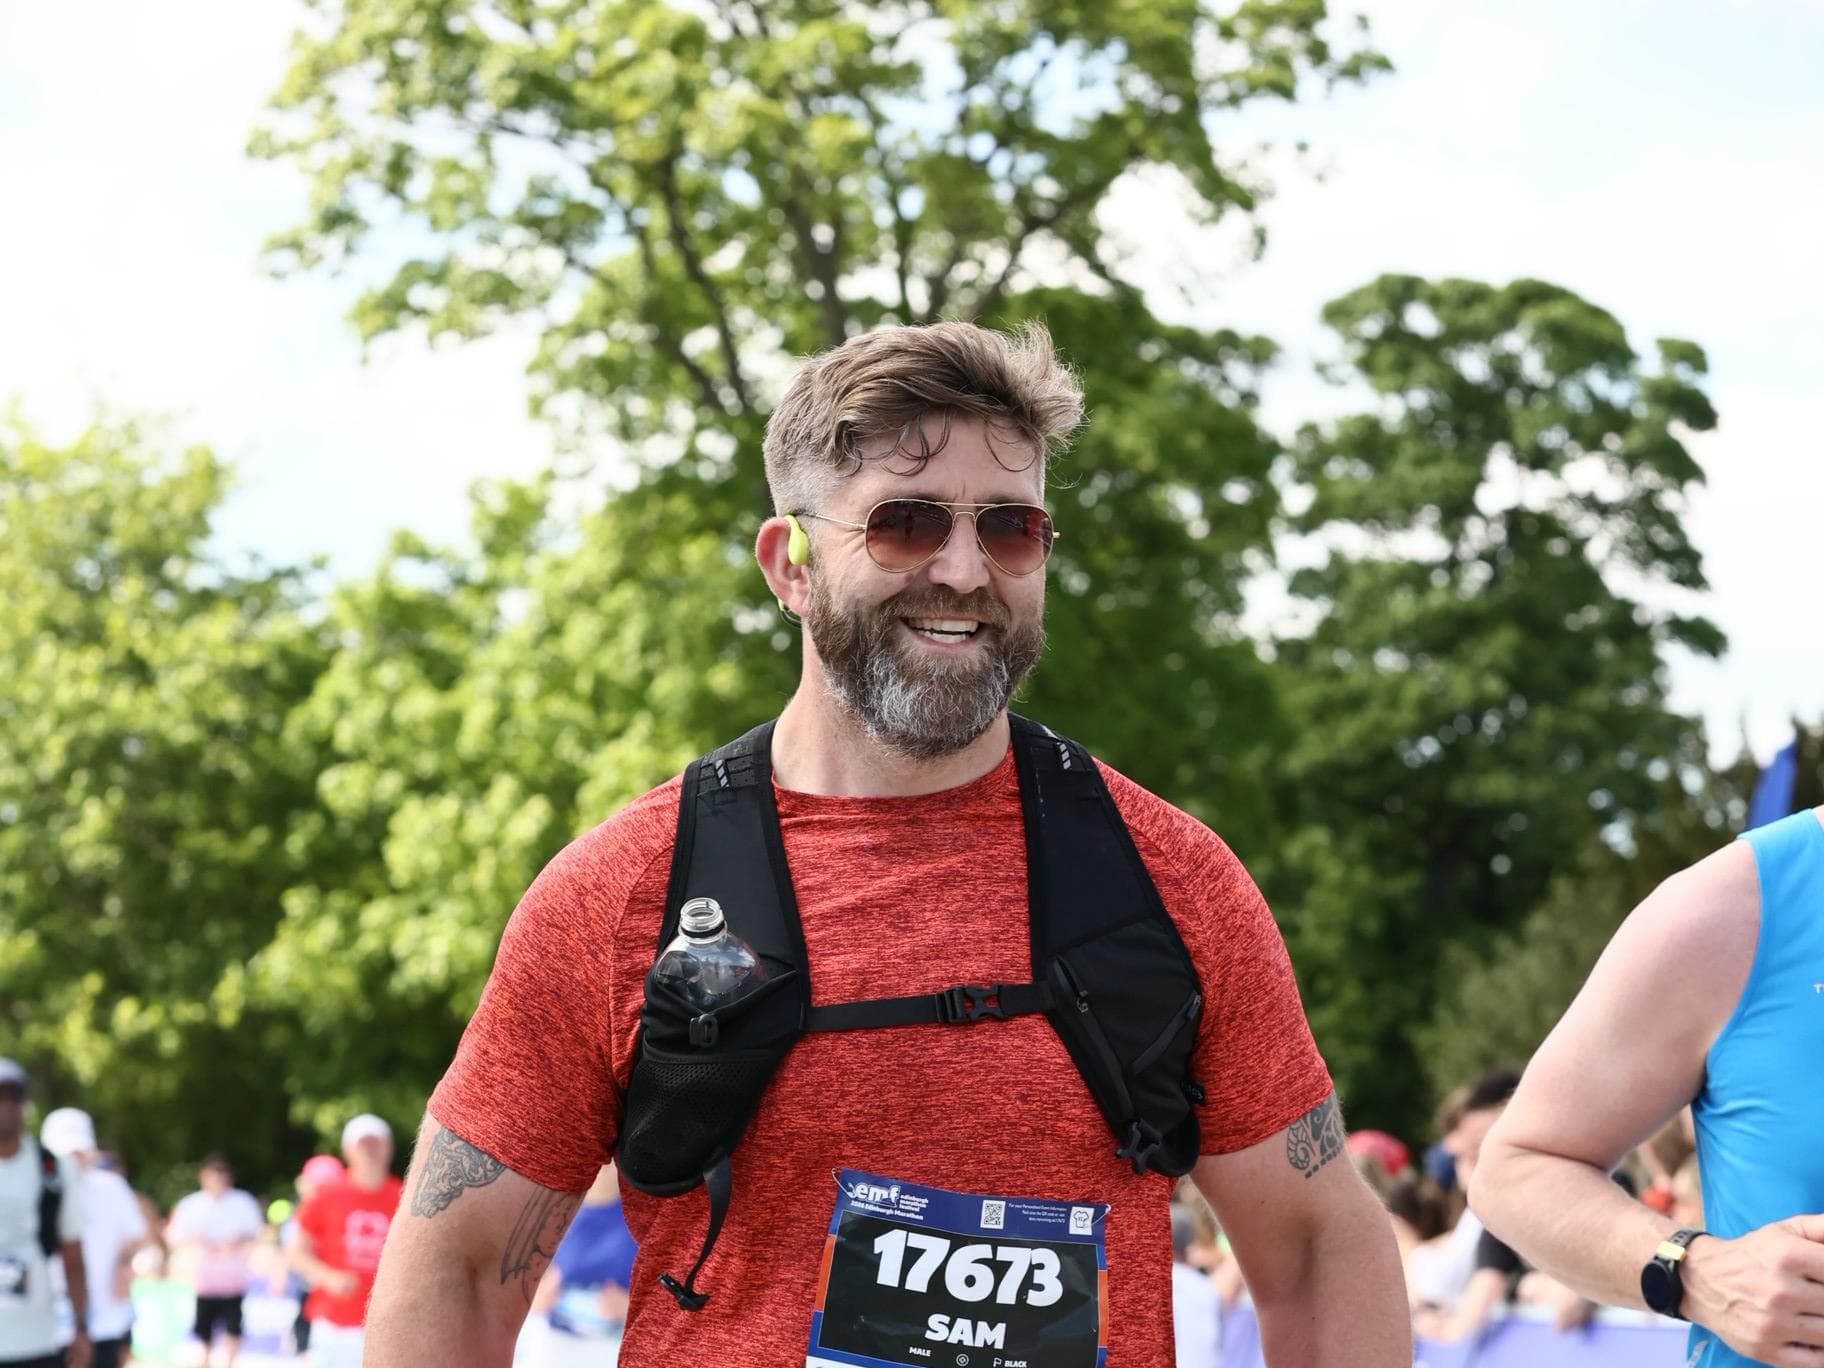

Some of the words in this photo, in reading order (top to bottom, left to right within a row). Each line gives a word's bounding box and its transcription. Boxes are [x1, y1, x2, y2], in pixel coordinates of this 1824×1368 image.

[854, 1182, 899, 1203] emf
[864, 1203, 894, 1216] Edinburgh
[894, 1209, 924, 1221] Marathon
[873, 1228, 1064, 1307] 17673
[924, 1313, 1007, 1350] SAM
[909, 1346, 931, 1357] MALE
[1004, 1360, 1027, 1368] BLACK
